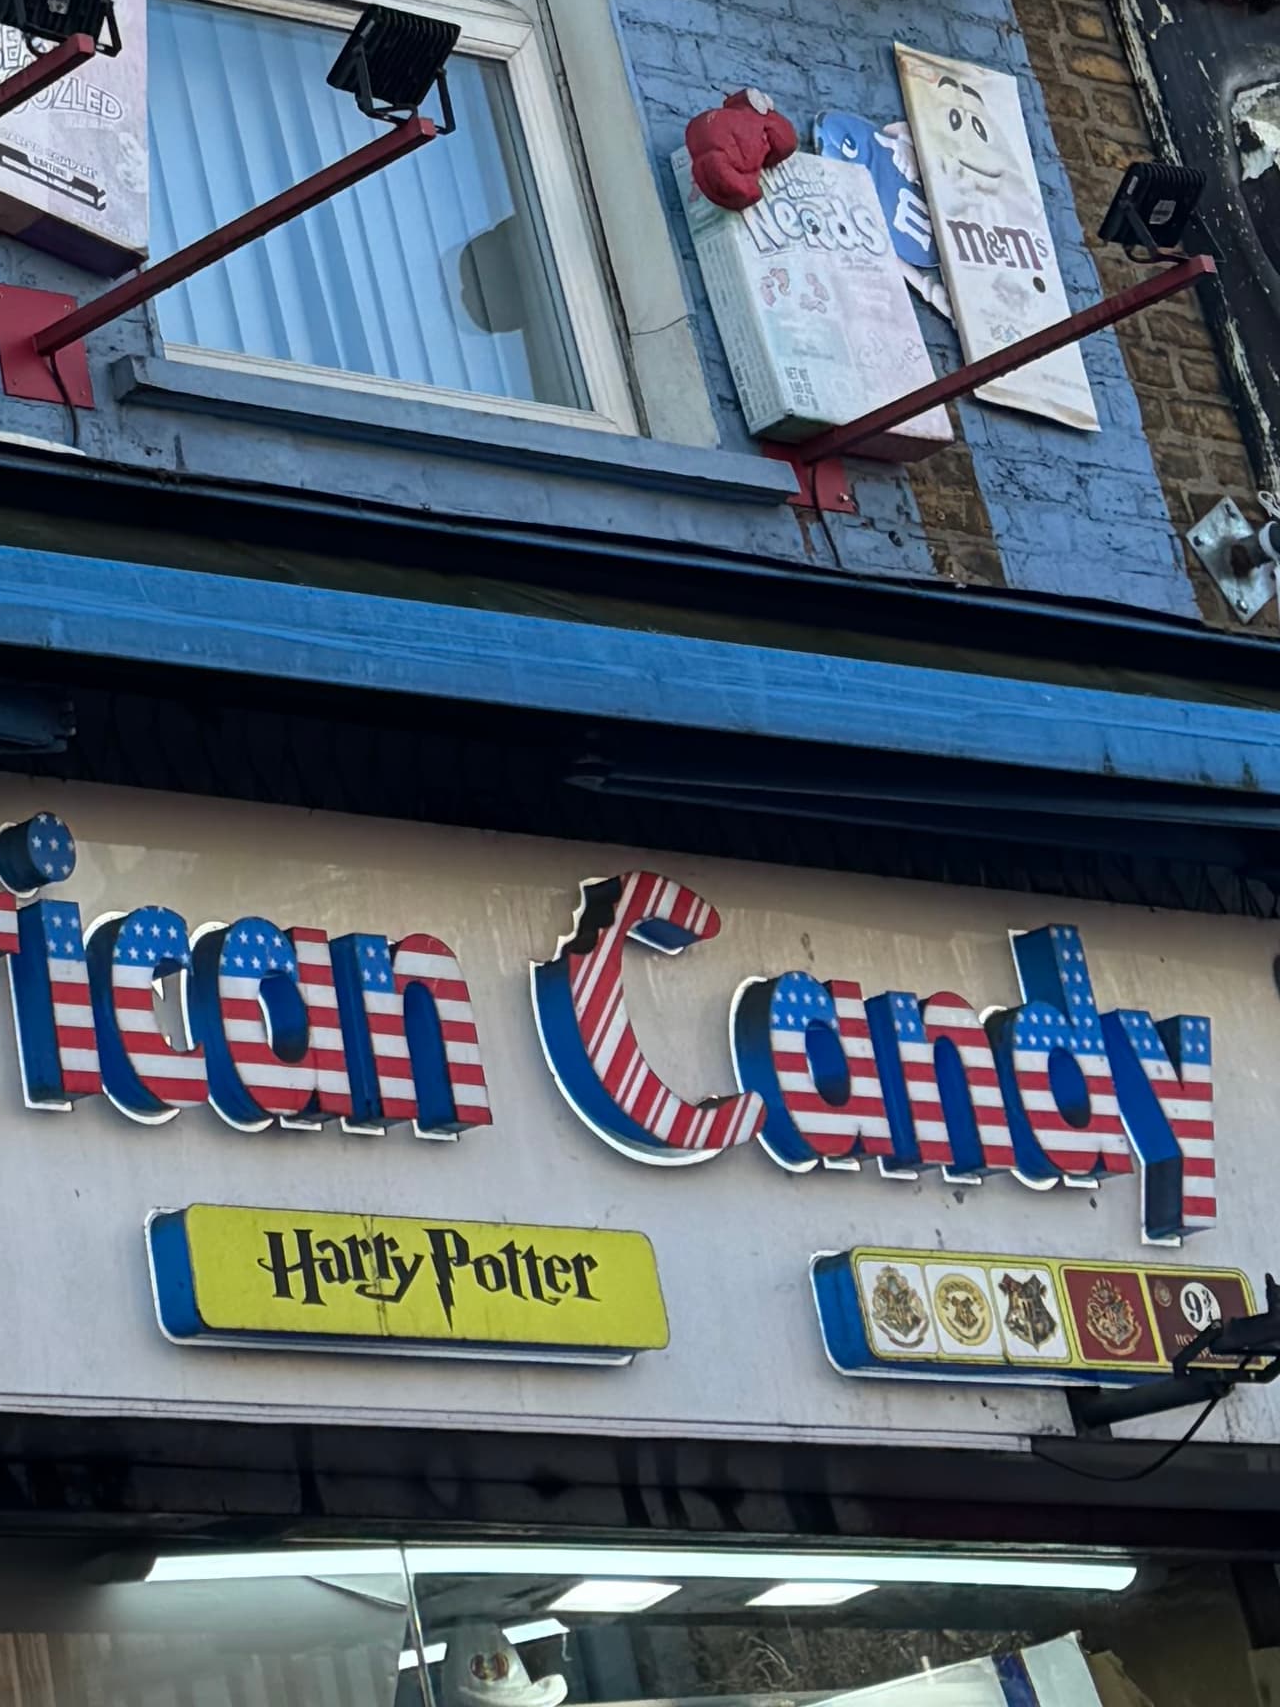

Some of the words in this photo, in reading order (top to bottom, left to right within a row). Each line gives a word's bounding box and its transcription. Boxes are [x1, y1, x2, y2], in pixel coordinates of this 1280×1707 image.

[550, 871, 1217, 1232] Candy
[258, 1228, 425, 1306] Harry
[422, 1228, 601, 1333] Potter
